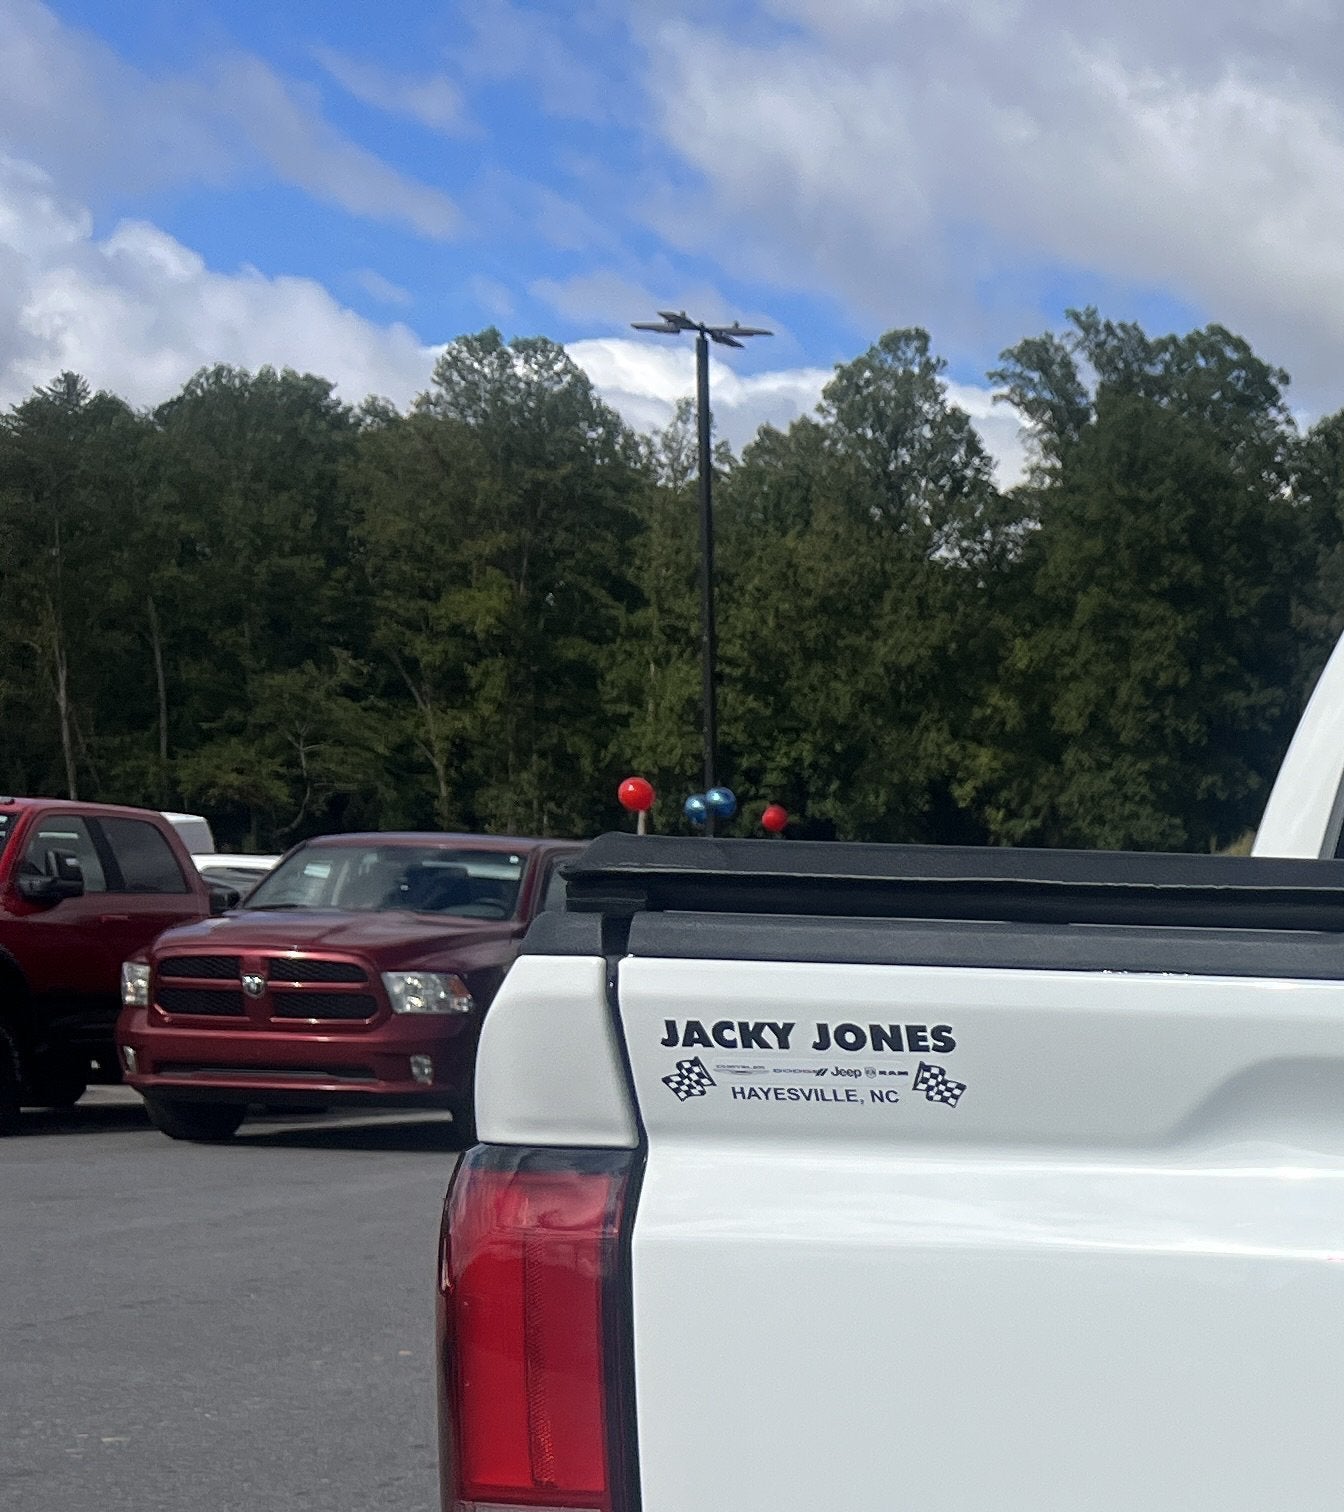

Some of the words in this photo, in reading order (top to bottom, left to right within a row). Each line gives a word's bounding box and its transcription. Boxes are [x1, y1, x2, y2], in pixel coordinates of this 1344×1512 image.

[660, 1019, 796, 1050] JACKY
[811, 1022, 957, 1053] JONES
[830, 1065, 863, 1079] Jeep
[731, 1085, 865, 1105] HAYESVILLE,
[869, 1088, 900, 1105] NC
